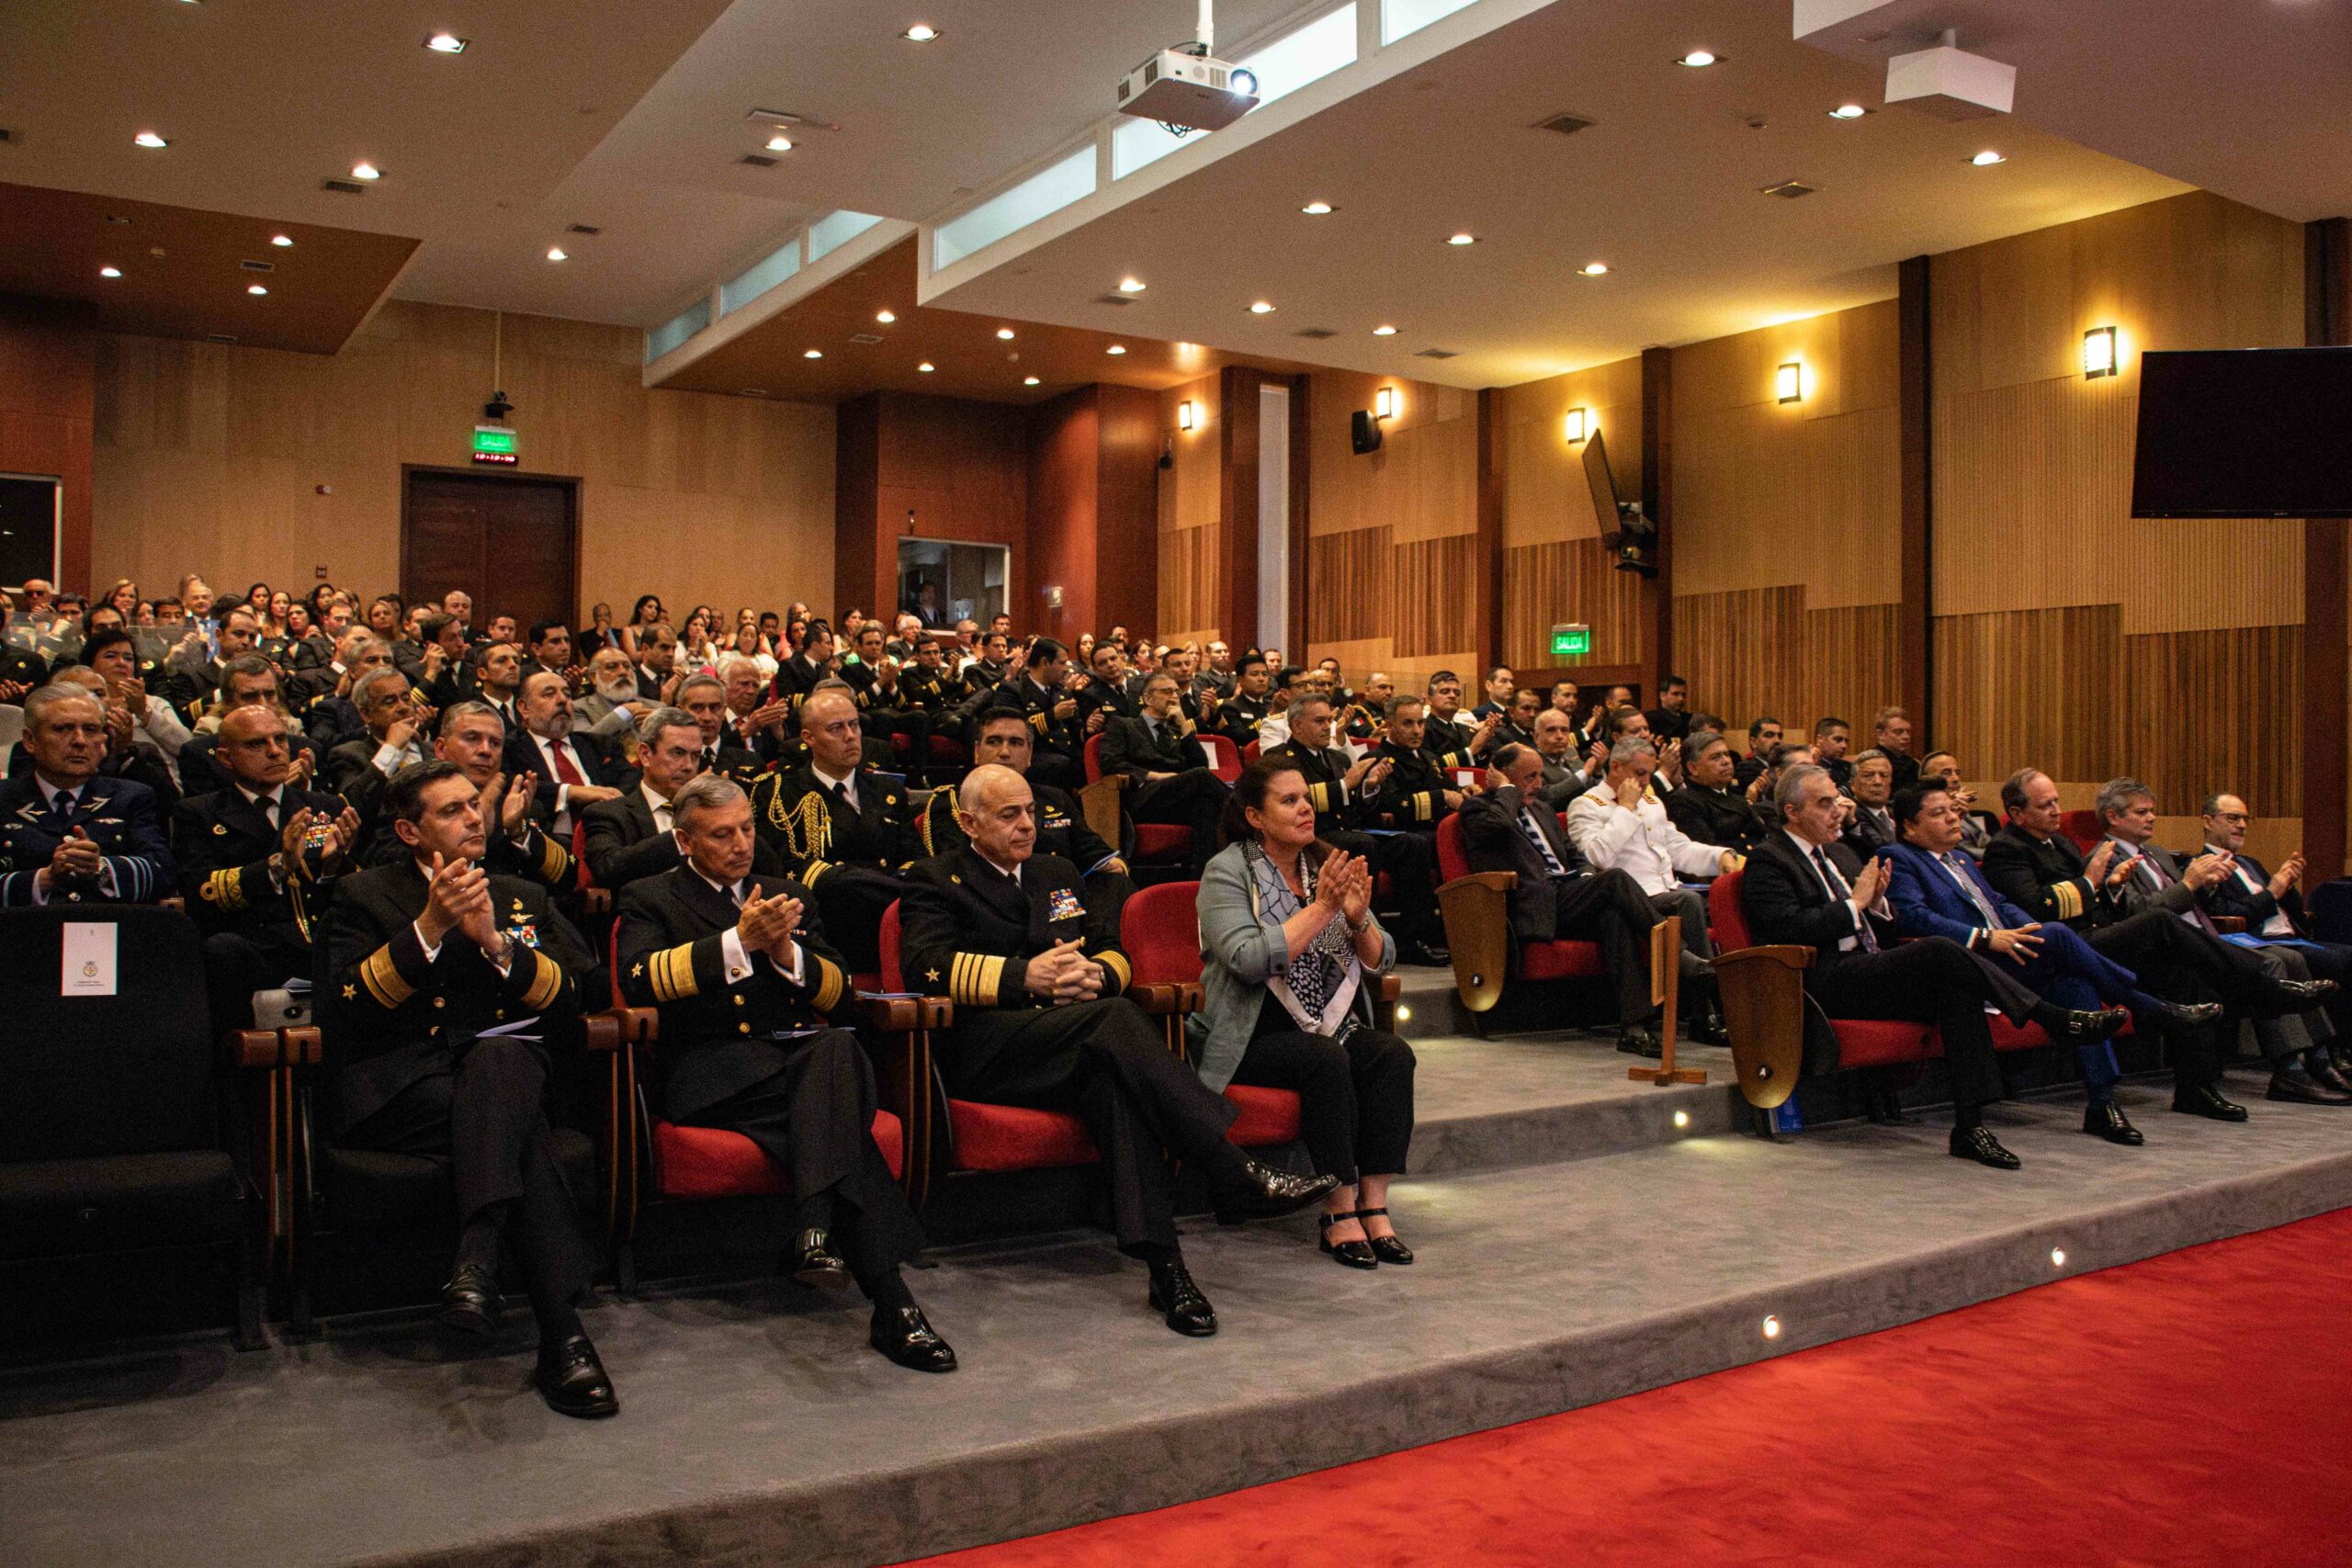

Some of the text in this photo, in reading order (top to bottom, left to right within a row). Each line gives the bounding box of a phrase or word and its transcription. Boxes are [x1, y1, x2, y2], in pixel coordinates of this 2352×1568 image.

[481, 434, 511, 447] SALIDA
[1555, 637, 1583, 650] SALIDA
[1759, 1067, 1767, 1077] A
